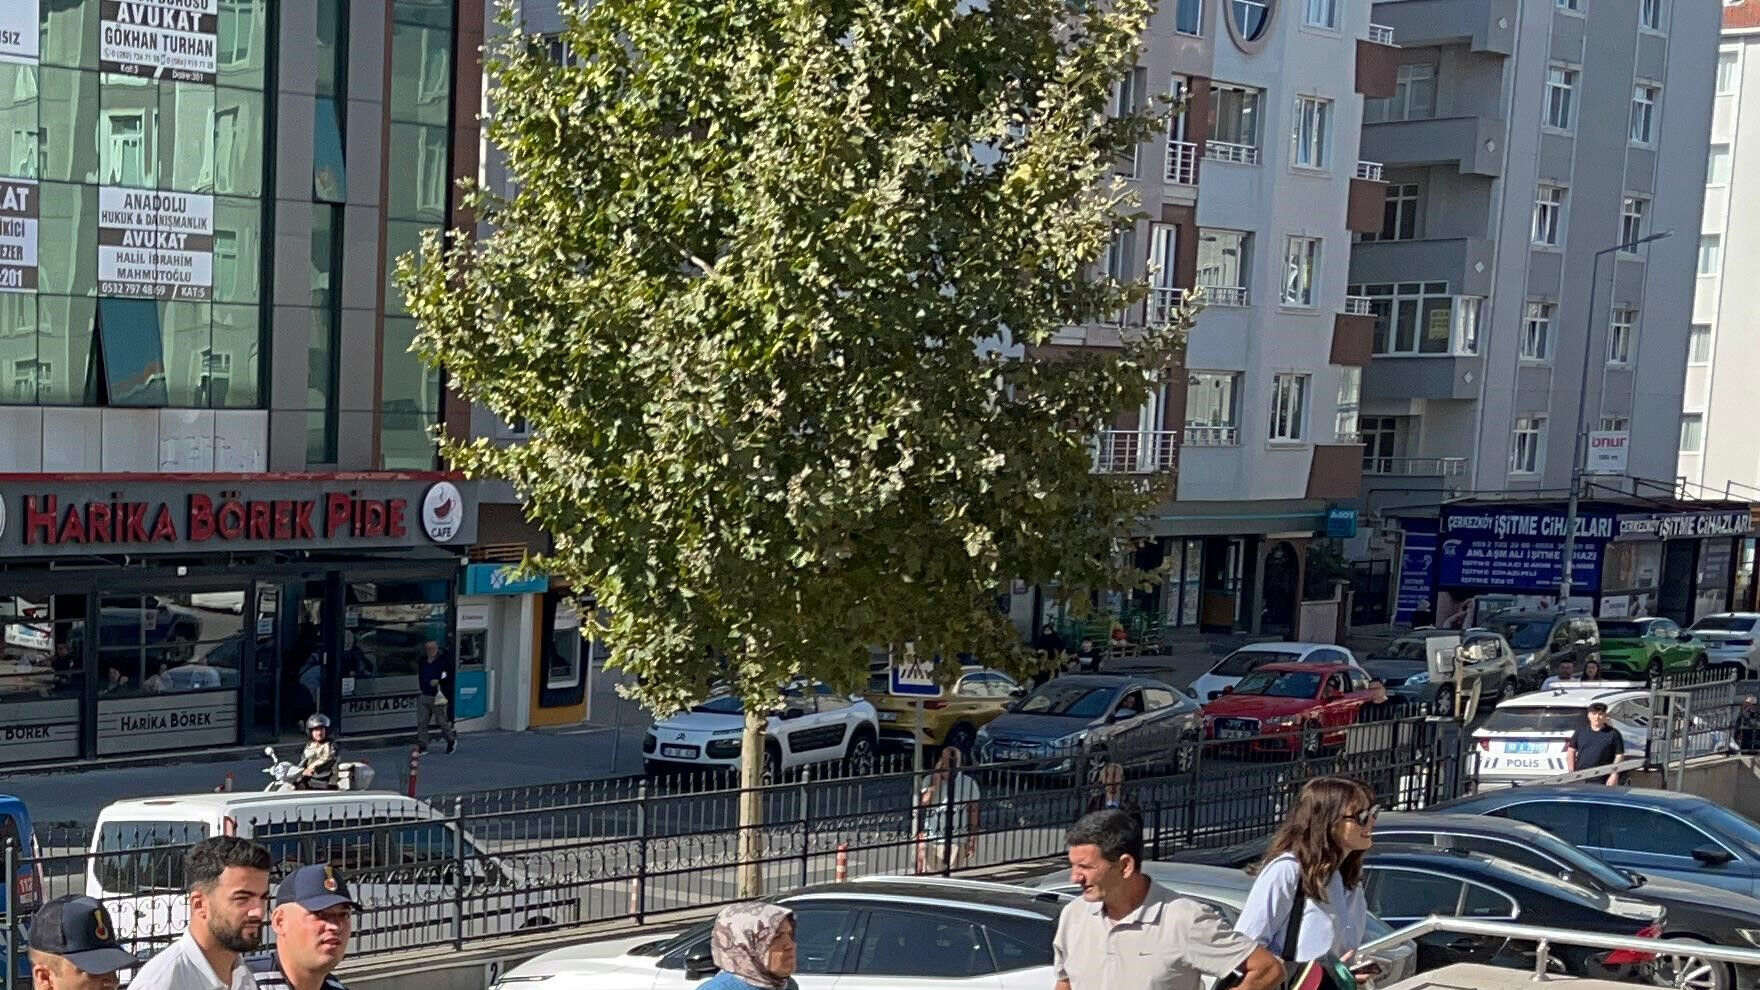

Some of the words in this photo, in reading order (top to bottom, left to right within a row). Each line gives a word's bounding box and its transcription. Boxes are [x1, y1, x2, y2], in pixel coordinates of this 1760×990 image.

[117, 3, 202, 32] AVUKAT
[105, 24, 158, 50] GÖKHAN
[162, 34, 213, 57] TURHAN
[124, 194, 187, 213] ANADOLU
[101, 210, 133, 225] HUKUK
[136, 215, 143, 225] &
[146, 214, 208, 231] DANIŞMANLIK
[122, 230, 188, 250] AVUKAT
[116, 250, 146, 264] HALİL
[148, 251, 193, 267] İBRAHİM
[117, 267, 192, 283] MAHMUTOĞLU
[101, 282, 123, 294] 0532
[23, 491, 178, 545] HARİKA
[187, 490, 316, 542] BÖREK
[325, 489, 408, 540] PİDE
[431, 527, 452, 539] CAFE
[121, 712, 168, 731] HARİKA
[170, 710, 212, 727] BÖREK
